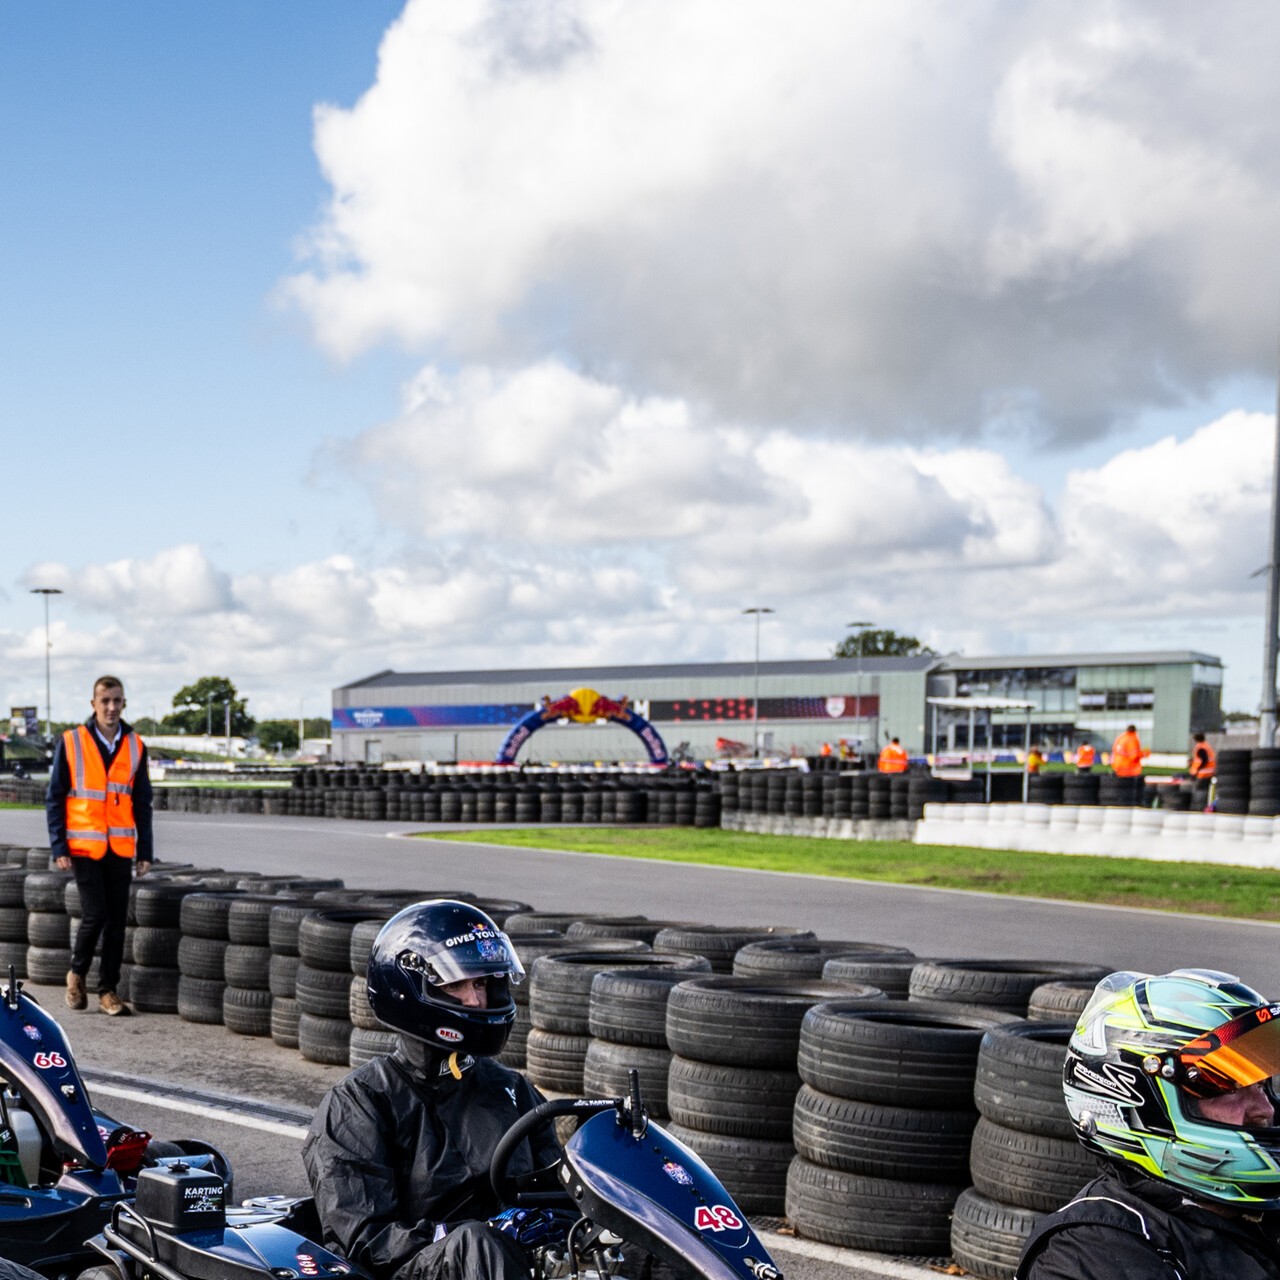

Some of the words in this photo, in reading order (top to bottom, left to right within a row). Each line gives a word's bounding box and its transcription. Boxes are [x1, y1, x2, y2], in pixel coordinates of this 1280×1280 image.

[446, 933, 475, 947] GIVES
[475, 930, 495, 941] YOU
[440, 1029, 460, 1040] BELL
[33, 1051, 67, 1069] 66
[184, 1186, 223, 1196] KARTING
[694, 1204, 744, 1233] 48
